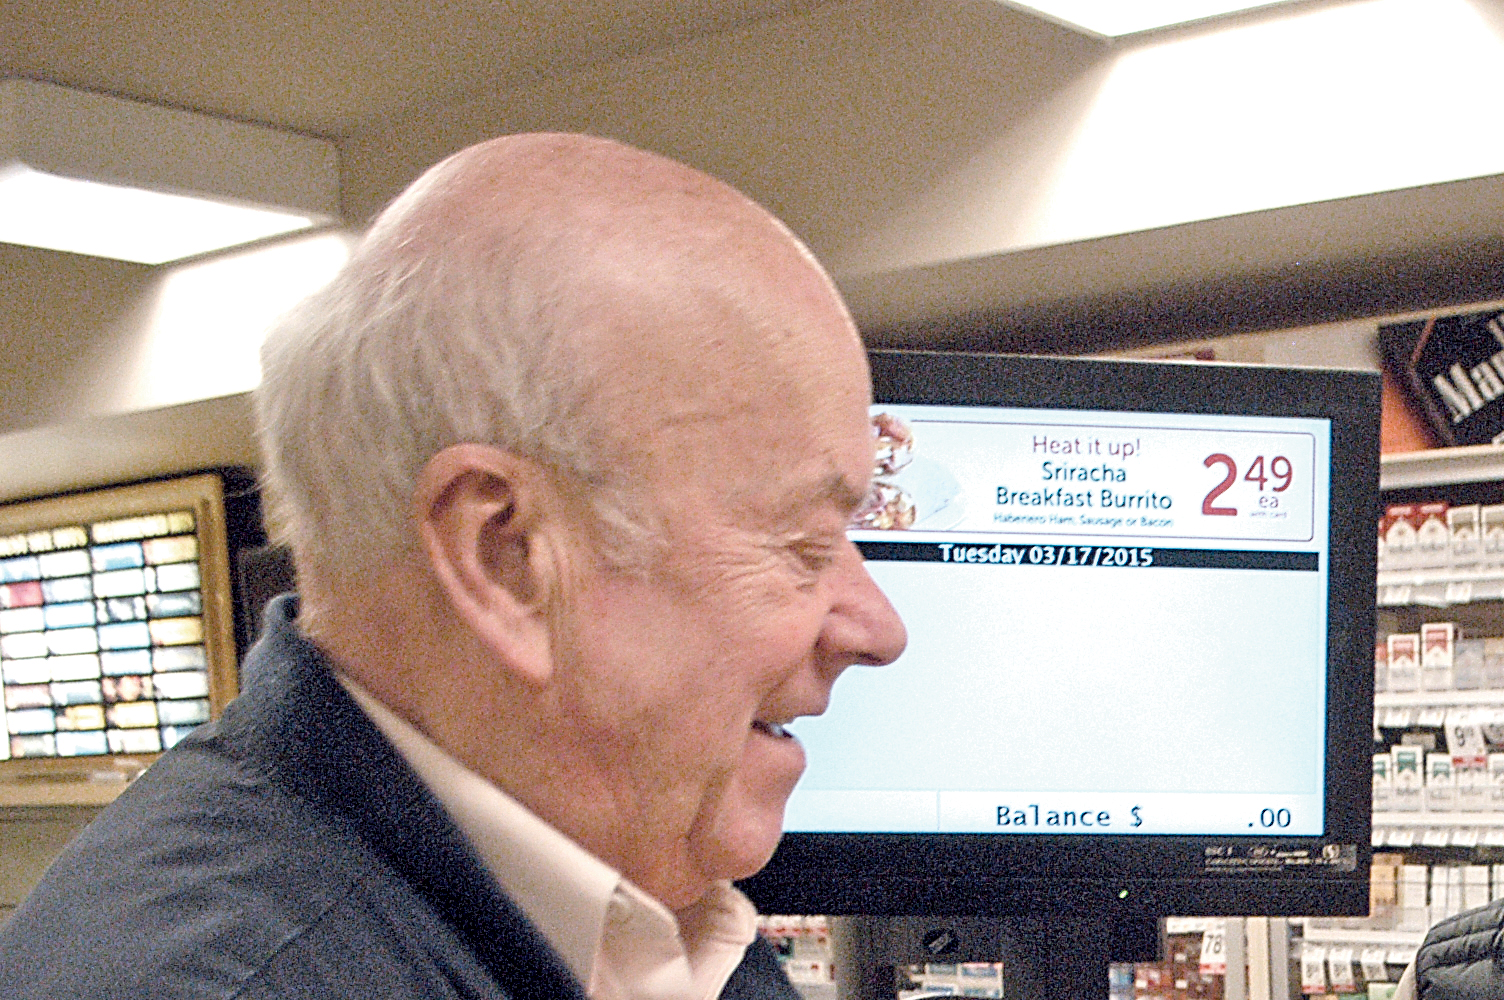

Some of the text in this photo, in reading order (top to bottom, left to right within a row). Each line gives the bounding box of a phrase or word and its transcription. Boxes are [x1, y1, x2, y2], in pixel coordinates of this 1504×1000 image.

[1032, 435, 1142, 459] Heat it up!
[1041, 462, 1127, 483] Sriracha
[1202, 453, 1293, 516] 2 49
[996, 486, 1173, 511] Breakfast Burrito
[1258, 496, 1279, 509] ea
[1080, 514, 1123, 529] Sausage
[1140, 516, 1174, 528] Bacon
[940, 543, 1153, 567] Tuesday 03/17/2015
[997, 805, 1291, 829] Balance $ .00
